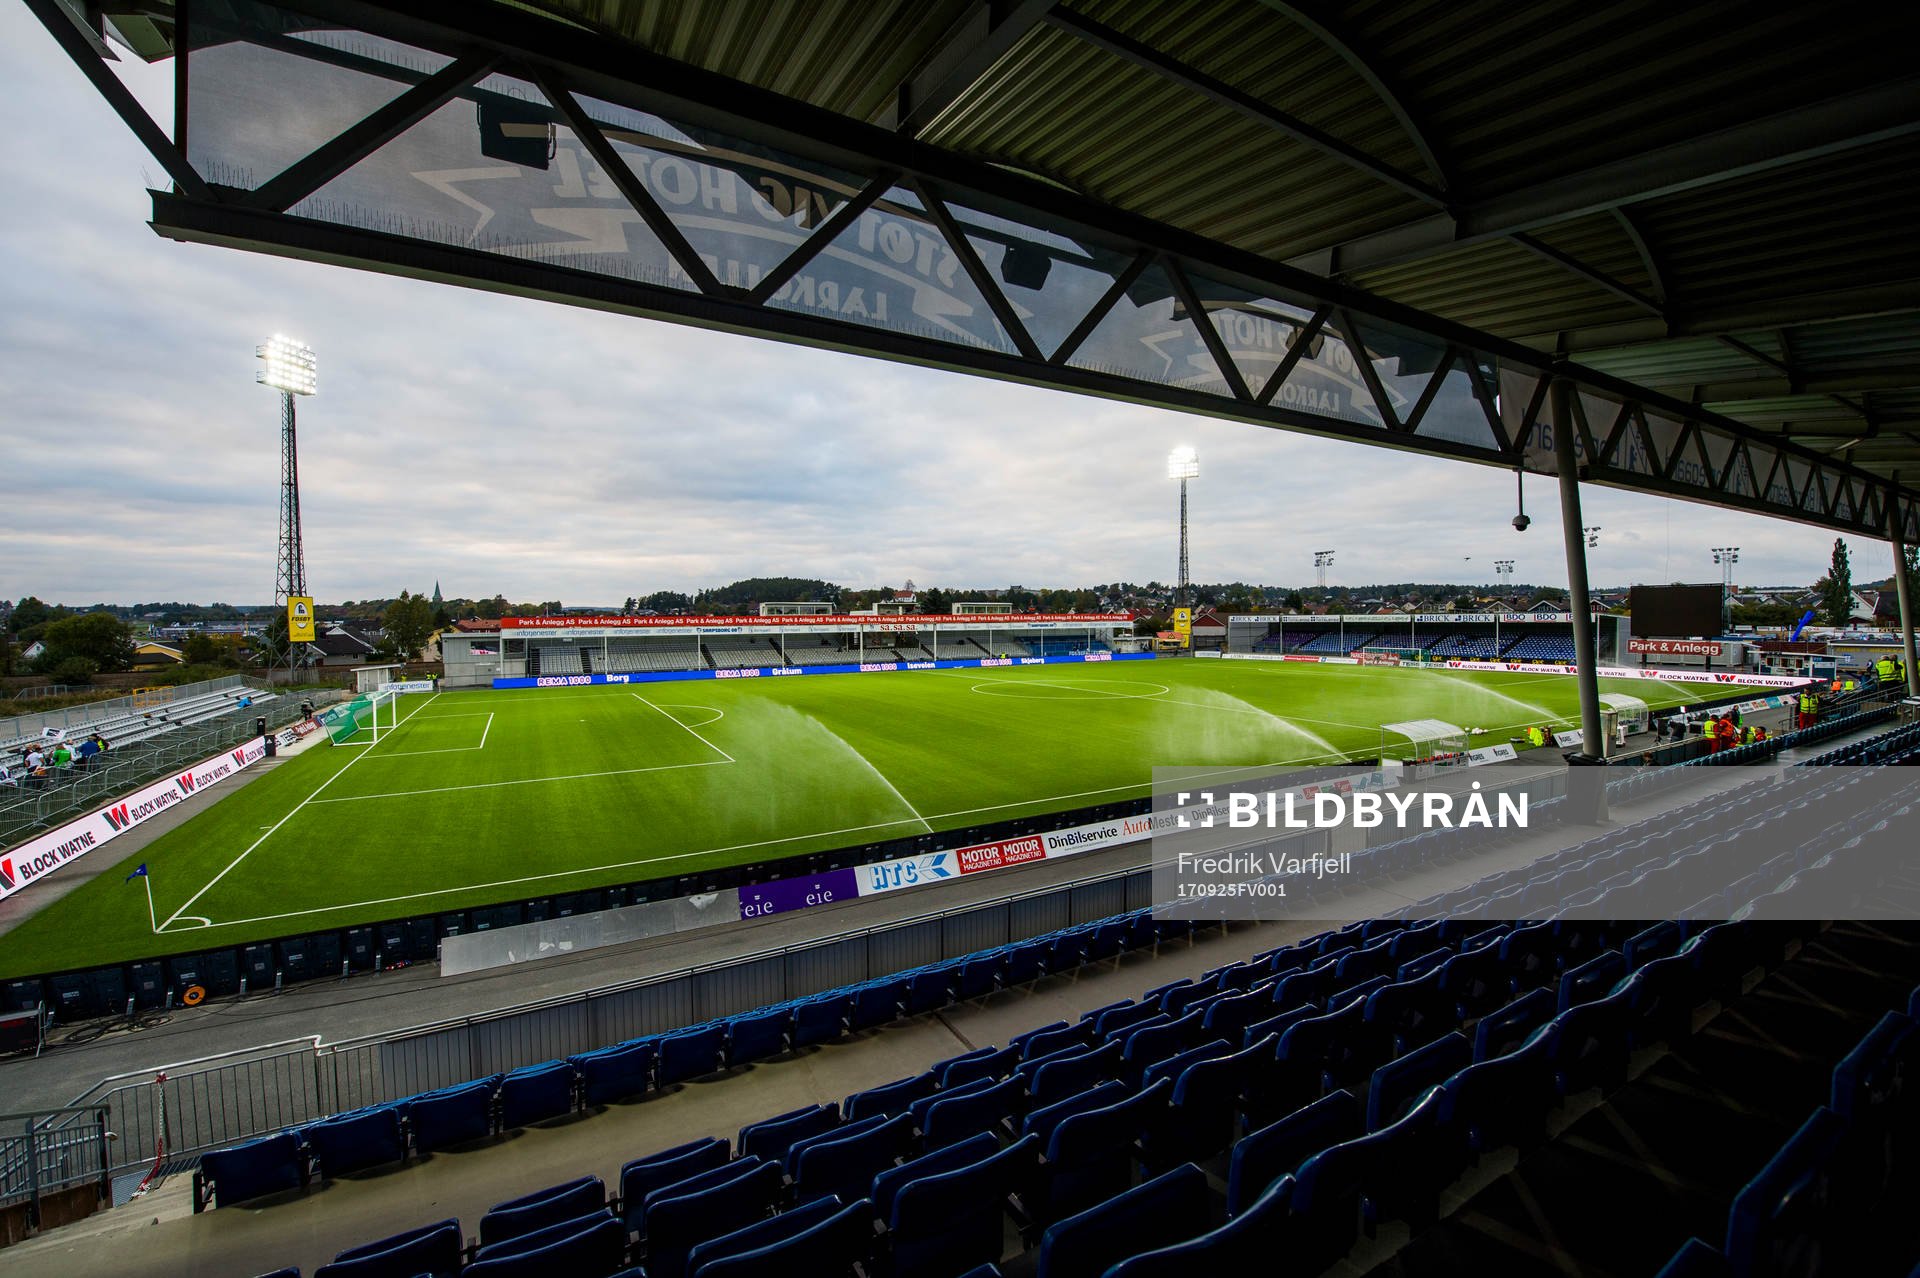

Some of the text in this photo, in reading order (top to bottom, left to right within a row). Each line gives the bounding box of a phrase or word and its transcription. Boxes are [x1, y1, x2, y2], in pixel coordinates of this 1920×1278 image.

[1629, 641, 1719, 655] Park & Anlegg
[715, 670, 741, 678] REMA
[741, 669, 760, 677] 1000
[860, 664, 881, 672] REMA
[537, 674, 630, 686] REMA 1000 Borg
[18, 849, 60, 881] BLOCK
[57, 831, 96, 859] WATNE
[131, 801, 157, 820] BLOCK
[153, 789, 180, 808] WATNE
[196, 772, 214, 787] BLOCK
[213, 764, 231, 779] WATNE
[1123, 813, 1183, 836] AutoMeste
[1048, 827, 1118, 849] DinBilservice
[961, 840, 1039, 864] MOTOR MOTOR
[963, 851, 1041, 871] MAGAZINET.NO MAGAZINET.NO
[870, 861, 918, 890] HTC
[745, 889, 833, 917] eie eie
